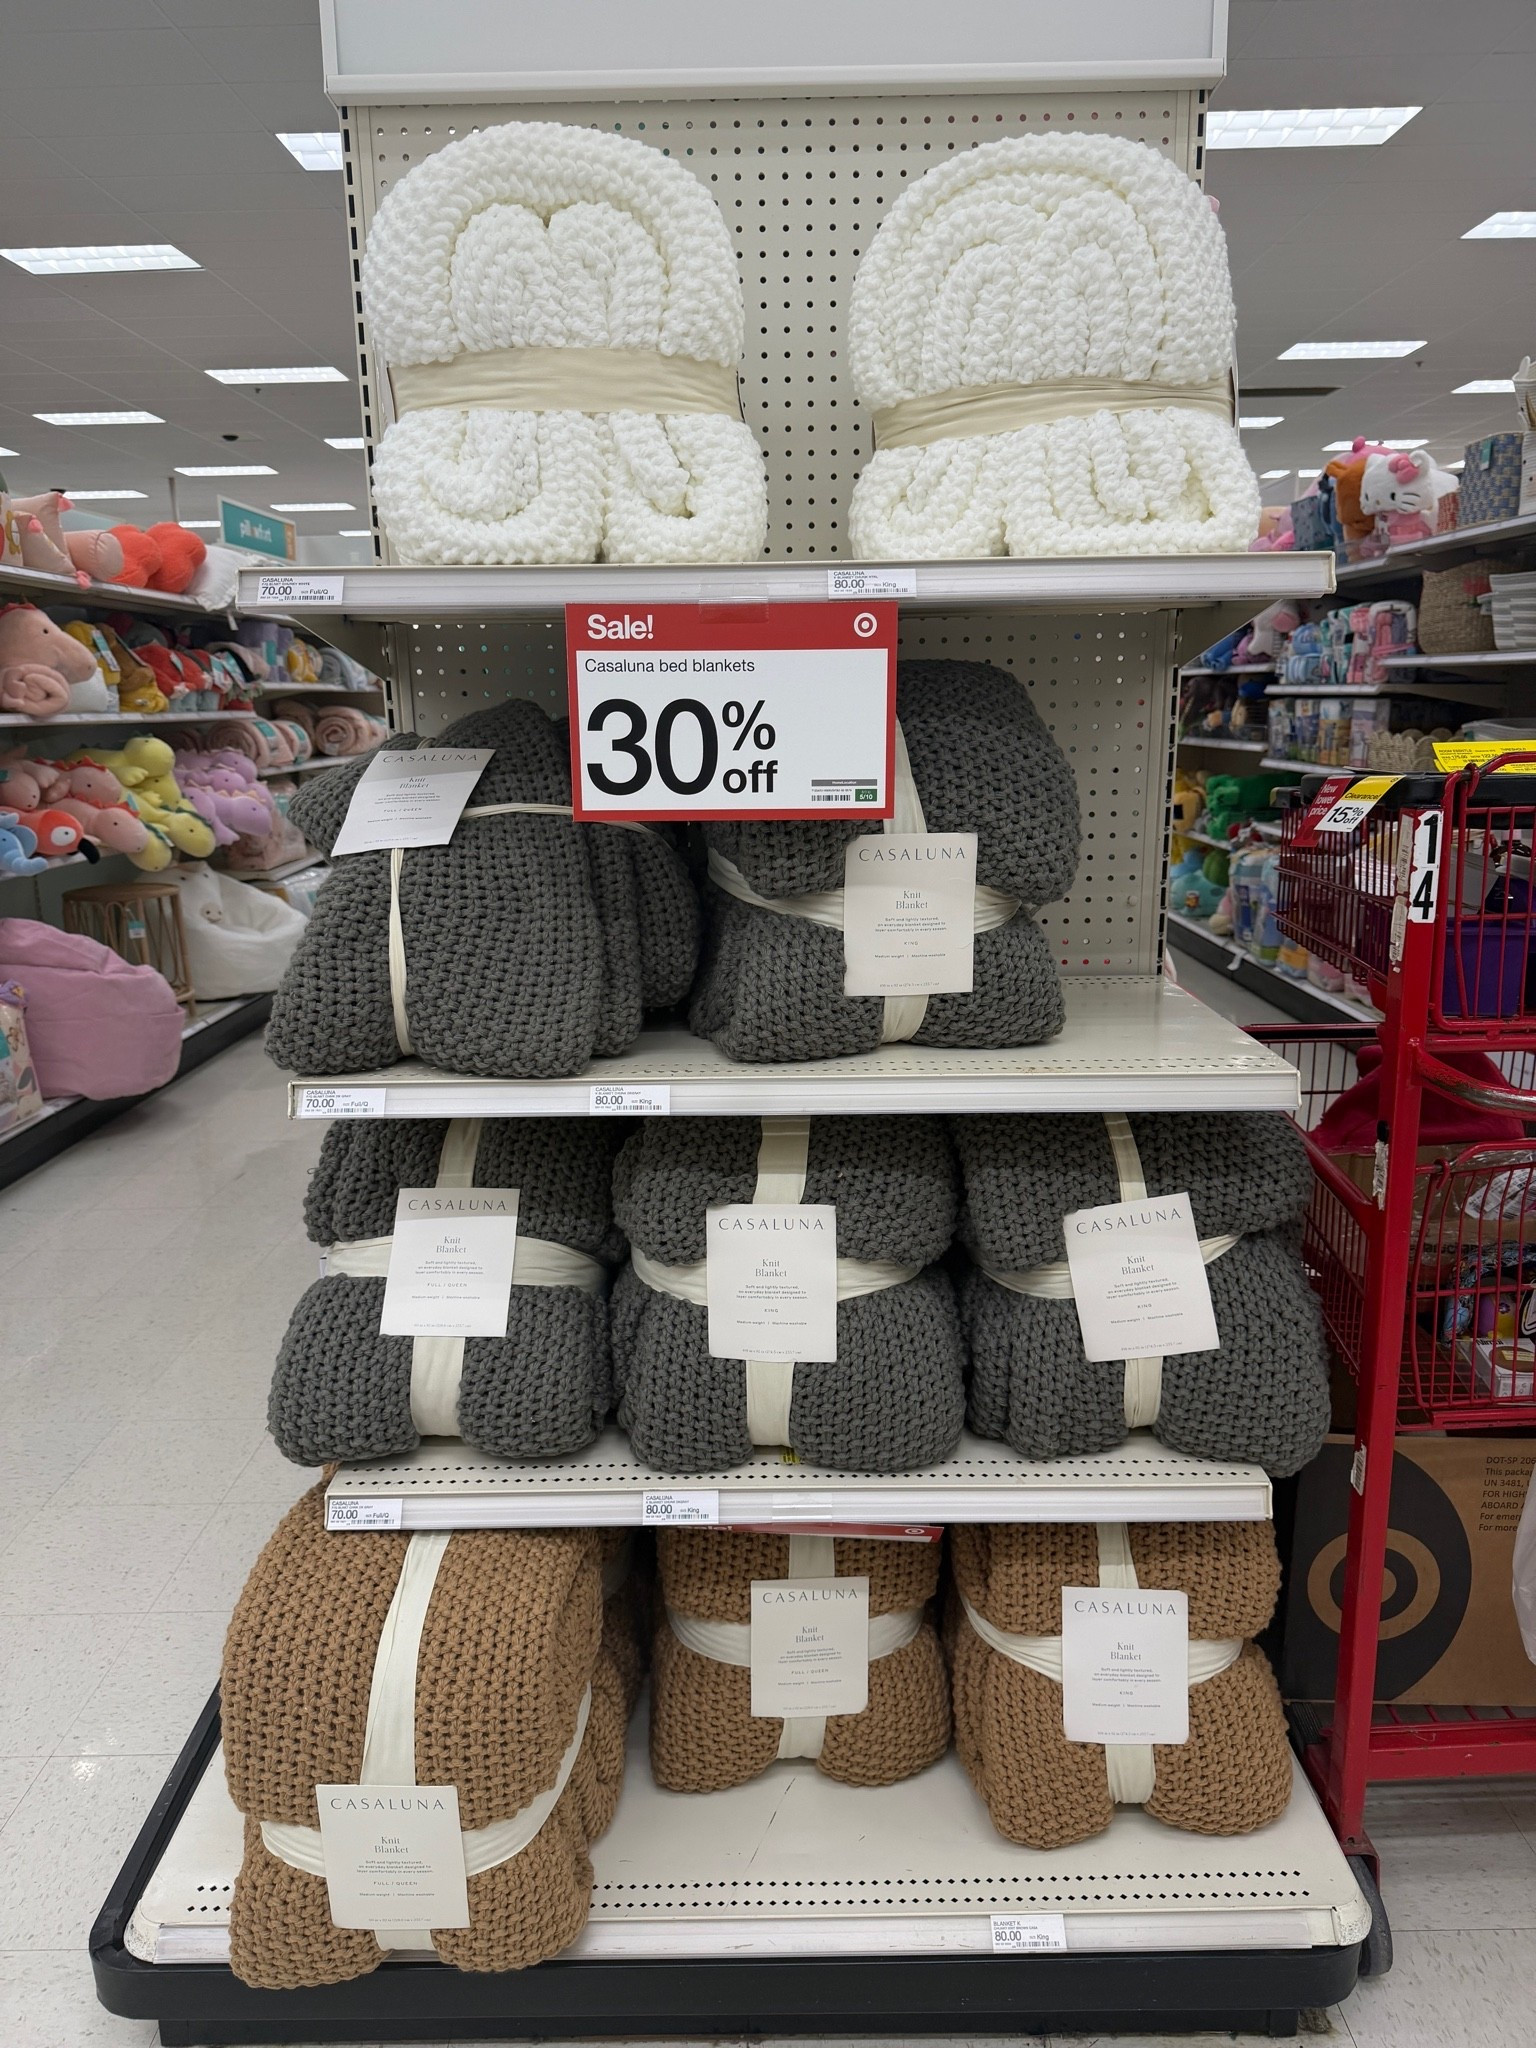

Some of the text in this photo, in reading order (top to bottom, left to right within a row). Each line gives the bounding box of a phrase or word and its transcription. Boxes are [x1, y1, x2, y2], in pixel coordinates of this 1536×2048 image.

[834, 580, 864, 588] 80.00
[262, 586, 292, 595] 70.00
[588, 614, 654, 640] Sale!
[585, 659, 755, 672] Casaluna bed blankets
[383, 754, 478, 763] CASALUNA
[722, 760, 778, 793] off
[1321, 784, 1338, 793] New
[1315, 795, 1336, 804] lower
[1308, 805, 1328, 817] price
[859, 847, 965, 862] CASALUNA
[904, 890, 921, 899] Knit
[896, 900, 928, 909] Blanket
[306, 1099, 334, 1108] 70.00
[595, 1096, 623, 1105] 80.00
[408, 1200, 506, 1210] CASALUNA
[719, 1218, 824, 1230] CASALUNA
[1076, 1208, 1182, 1234] CASALUNA
[1127, 1256, 1145, 1264] Knit
[1122, 1265, 1154, 1275] Blanket
[646, 1505, 672, 1514] 80.00
[332, 1510, 358, 1519] 70.00
[763, 1589, 858, 1603] CASALUNA
[1075, 1600, 1176, 1615] CASALUNA
[796, 1634, 824, 1643] Blanket
[1118, 1642, 1134, 1650] Knit
[1110, 1652, 1141, 1660] Blanket
[331, 1798, 444, 1810] CASALUNA
[995, 1931, 1021, 1941] 80.00
